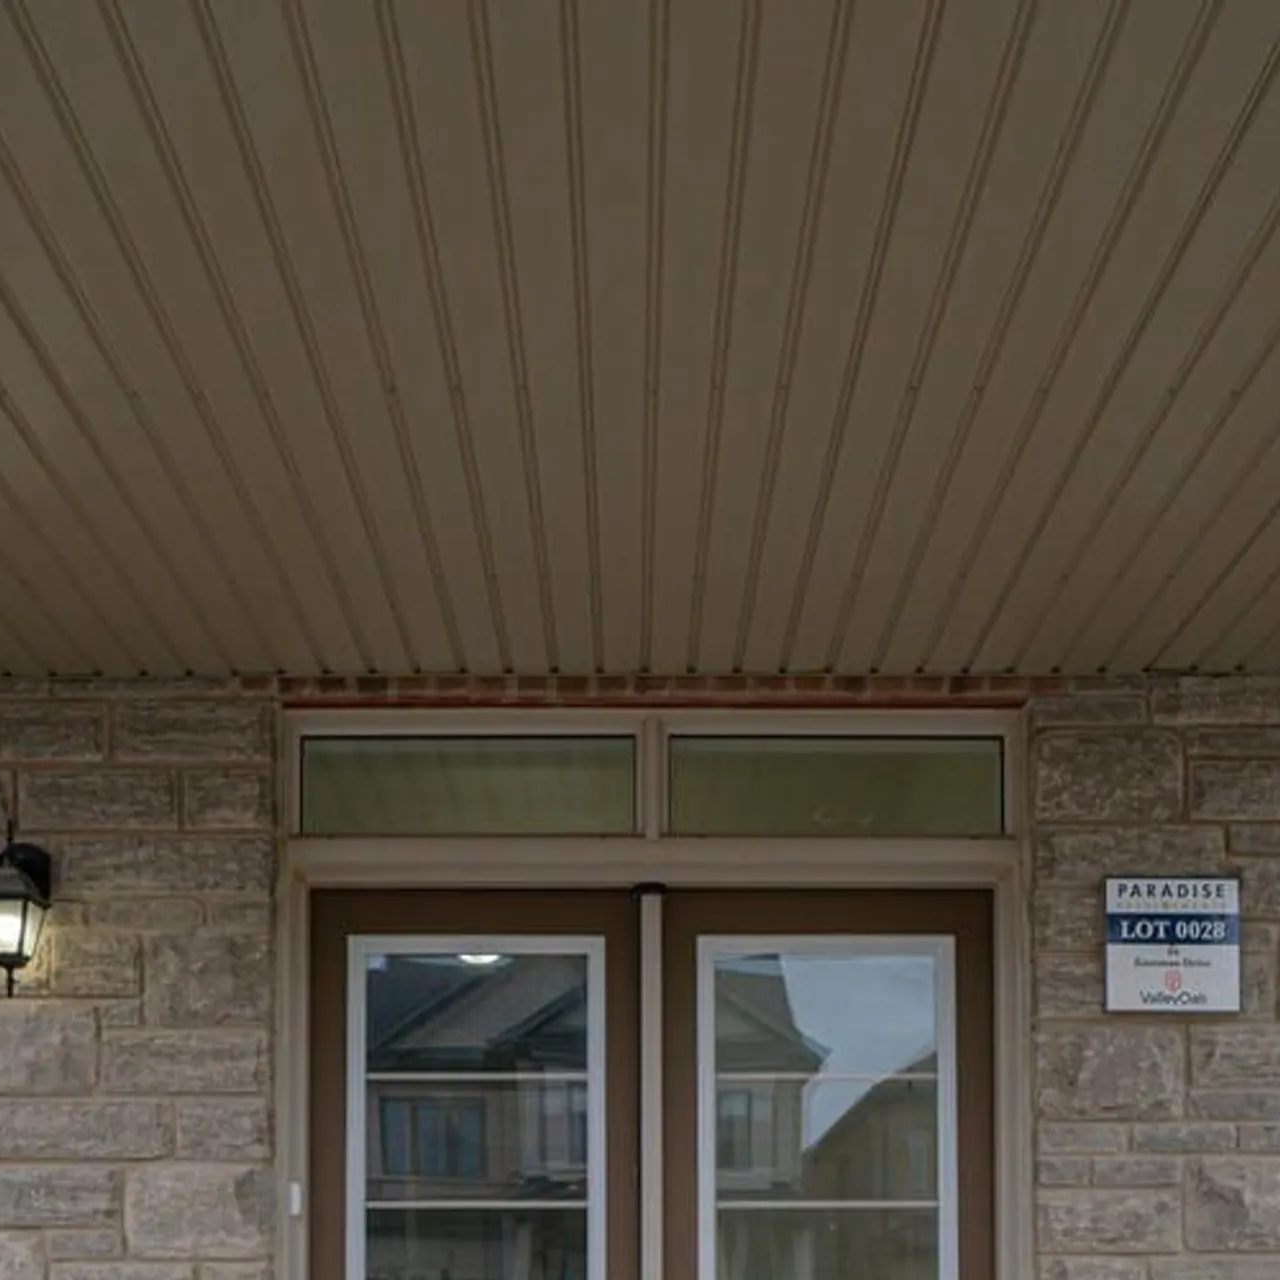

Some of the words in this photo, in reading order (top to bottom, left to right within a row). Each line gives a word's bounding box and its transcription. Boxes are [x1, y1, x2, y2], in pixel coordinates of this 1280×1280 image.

[1117, 883, 1226, 898] PARADISE
[1120, 920, 1170, 939] LOT
[1175, 920, 1226, 940] 0028
